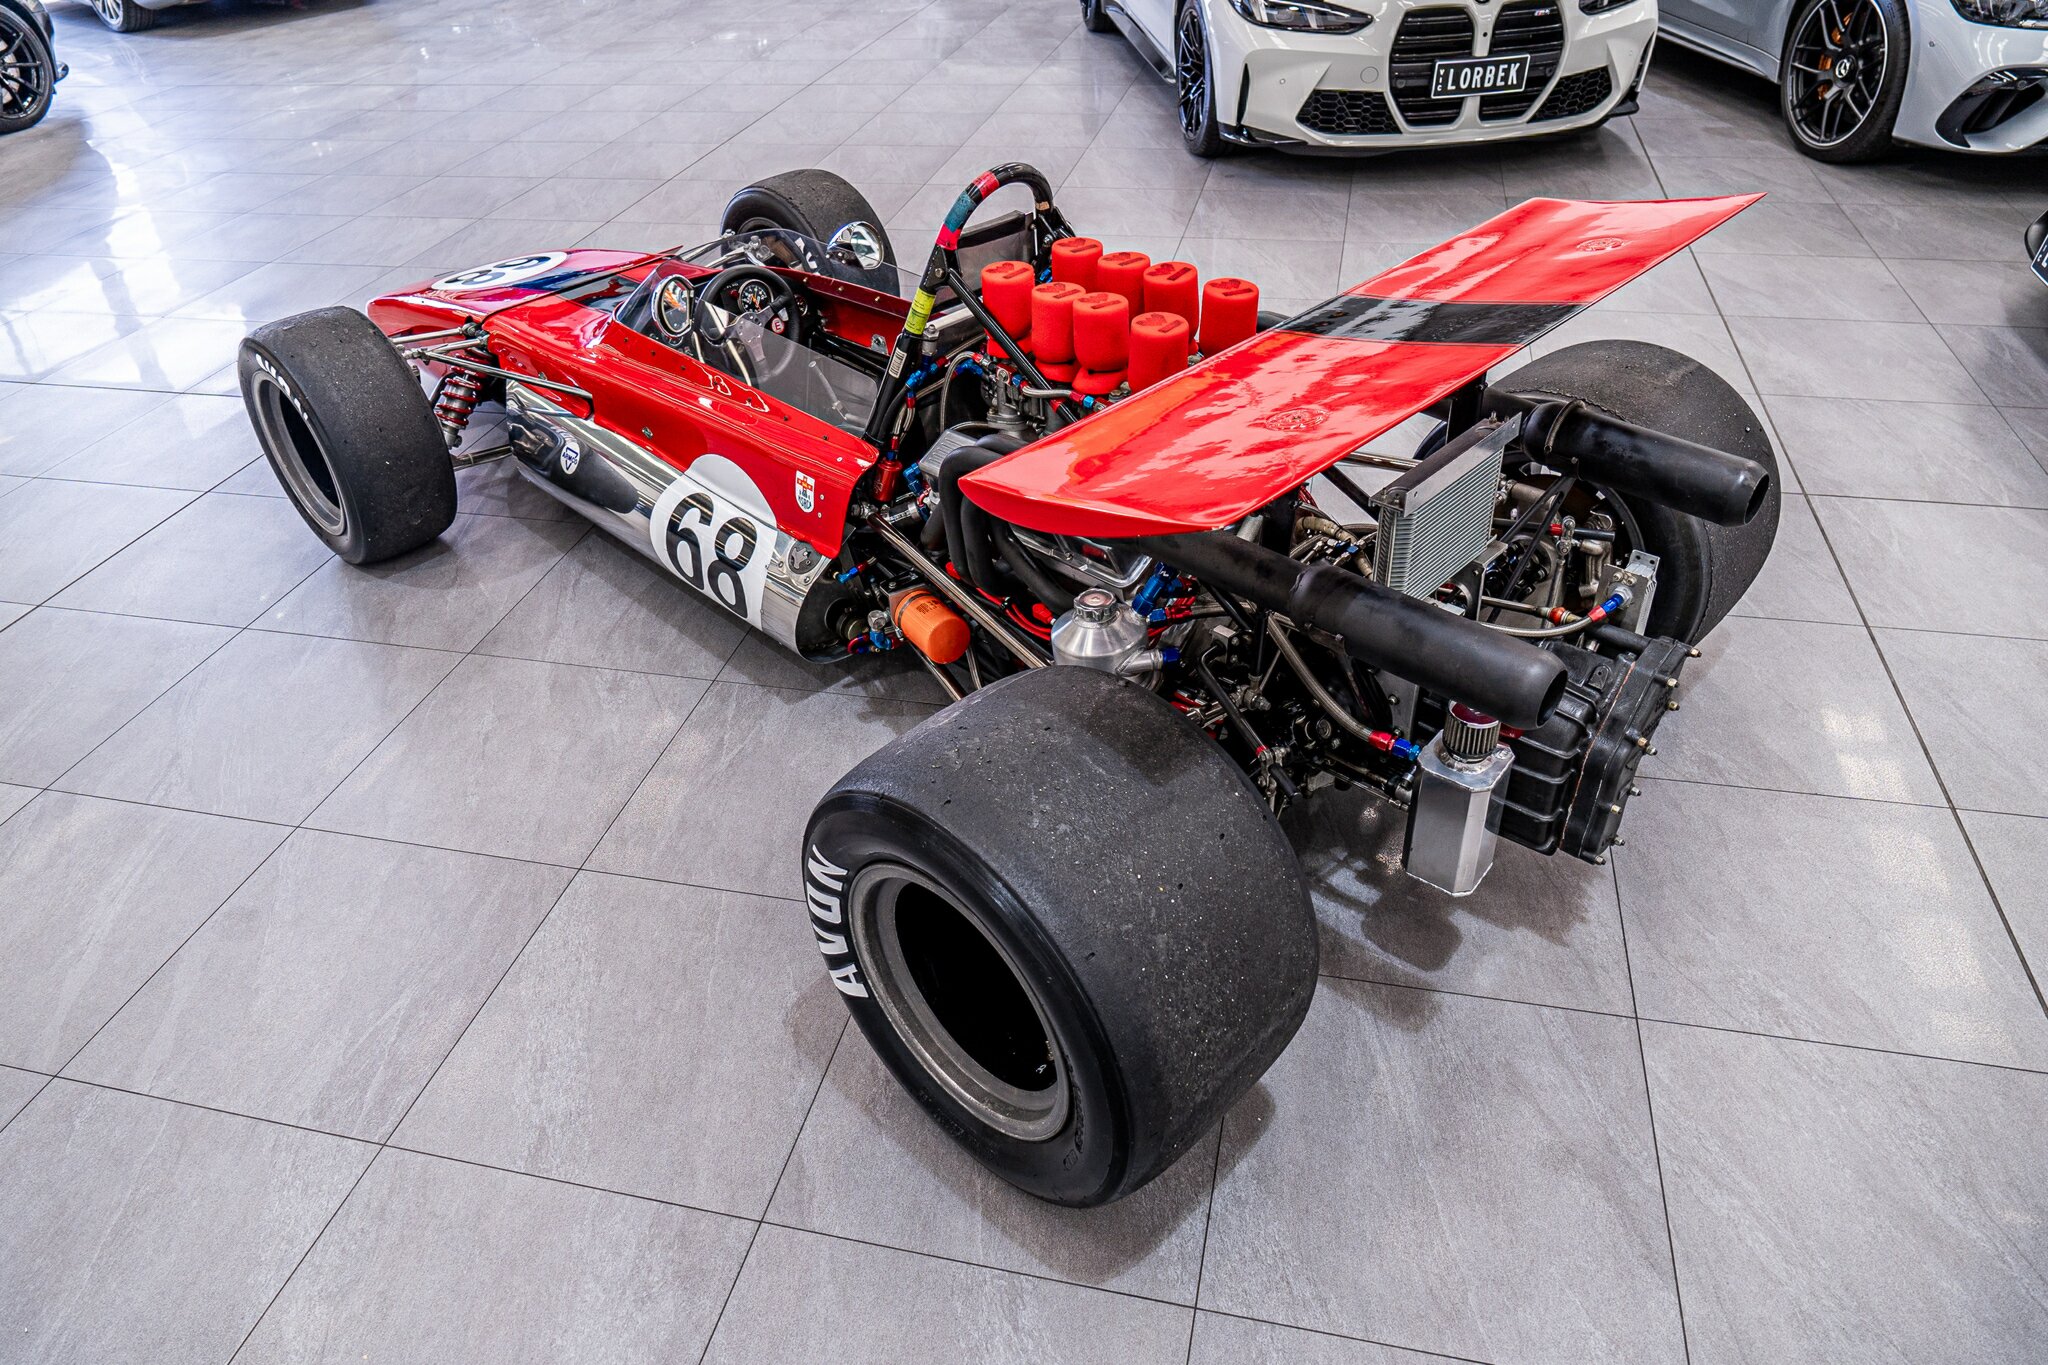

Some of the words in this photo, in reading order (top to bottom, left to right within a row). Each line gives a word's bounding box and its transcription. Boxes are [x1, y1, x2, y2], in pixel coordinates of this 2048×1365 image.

[1437, 69, 1445, 91] VIC
[1447, 62, 1520, 90] LORBEK
[774, 321, 782, 330] E
[666, 492, 757, 618] 68
[807, 844, 869, 998] AVON
